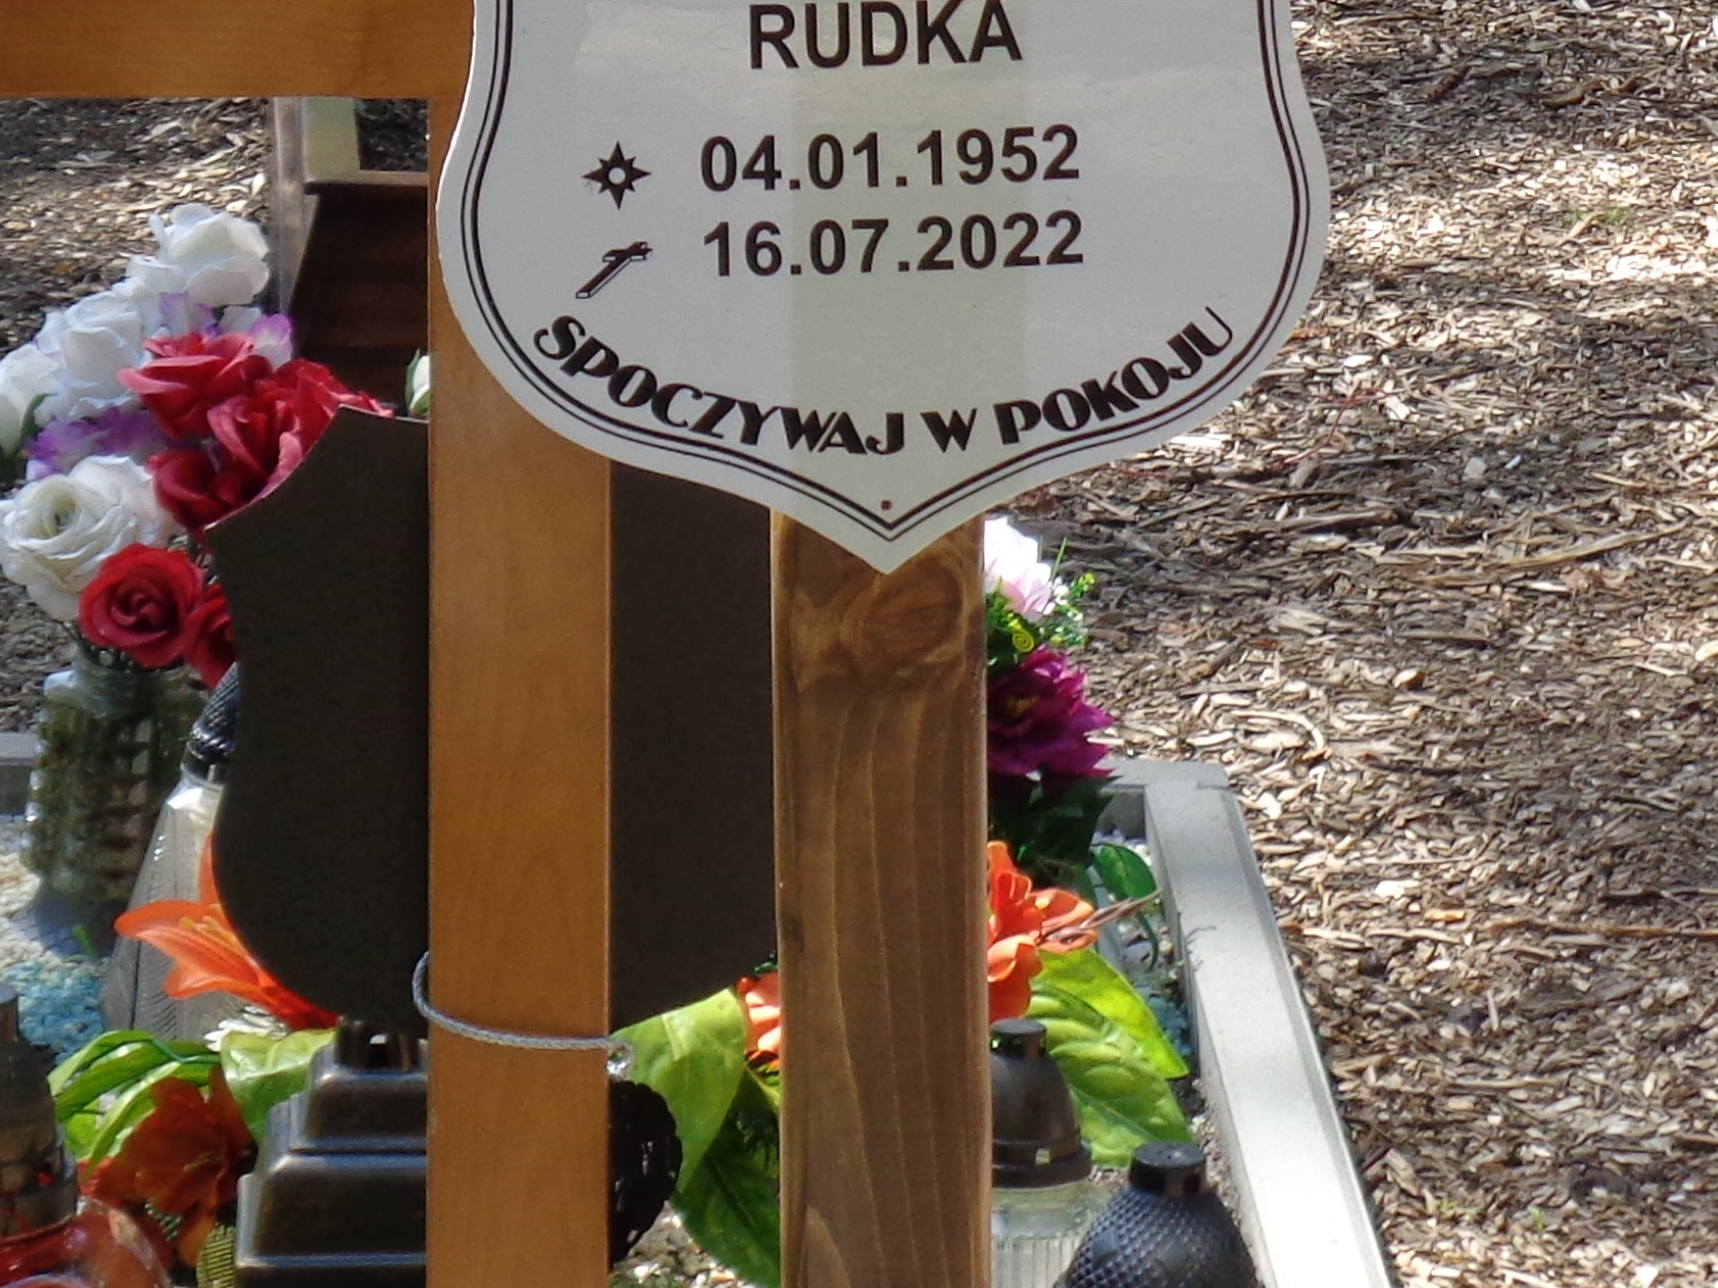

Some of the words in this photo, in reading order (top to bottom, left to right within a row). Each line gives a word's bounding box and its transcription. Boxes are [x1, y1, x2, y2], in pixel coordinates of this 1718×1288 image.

[701, 124, 1080, 192] 04.01.1952
[704, 210, 1084, 277] 16.07.2022
[533, 314, 905, 455] SPOCZYWAJ
[919, 408, 978, 453] W
[994, 305, 1232, 447] POKOJU
